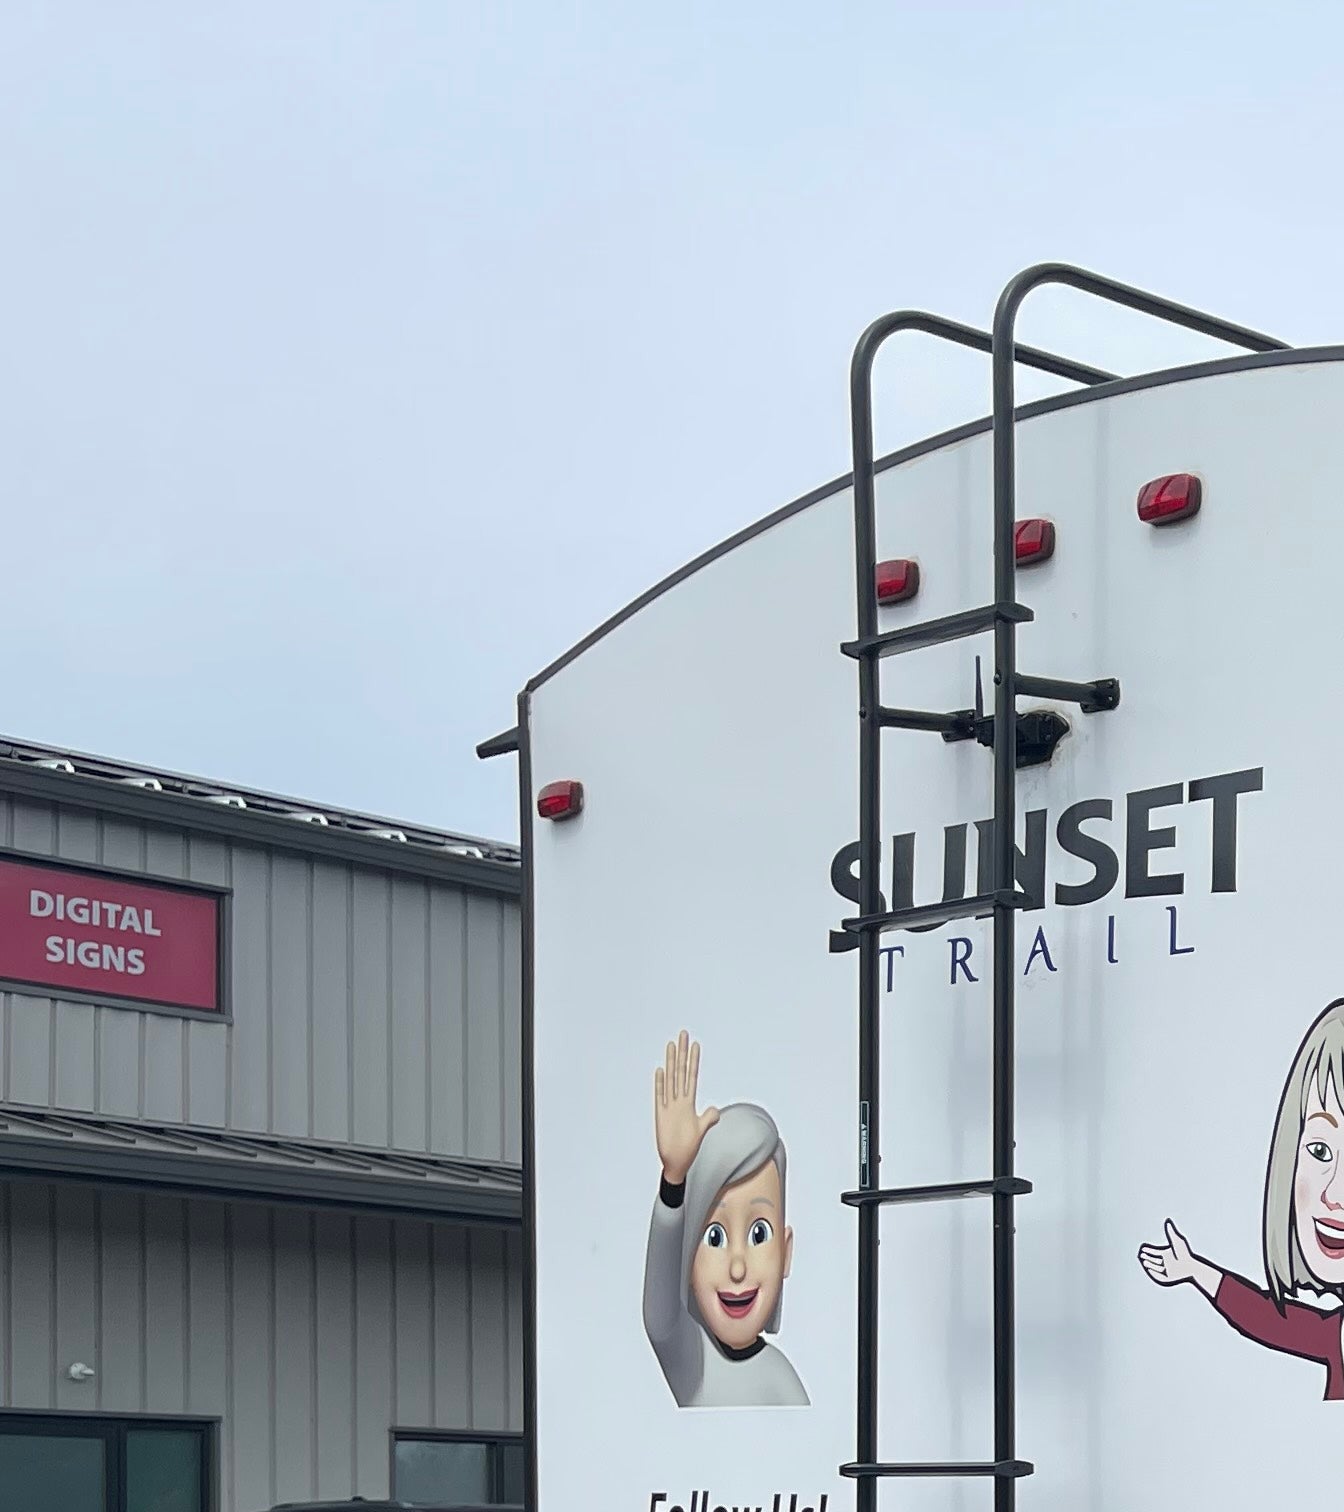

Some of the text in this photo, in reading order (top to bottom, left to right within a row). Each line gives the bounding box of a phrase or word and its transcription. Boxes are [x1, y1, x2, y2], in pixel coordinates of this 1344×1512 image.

[829, 766, 1264, 953] SUNSET
[29, 889, 162, 937] DIGITAL
[45, 935, 146, 975] SIGNS
[876, 905, 1196, 994] TRAIL
